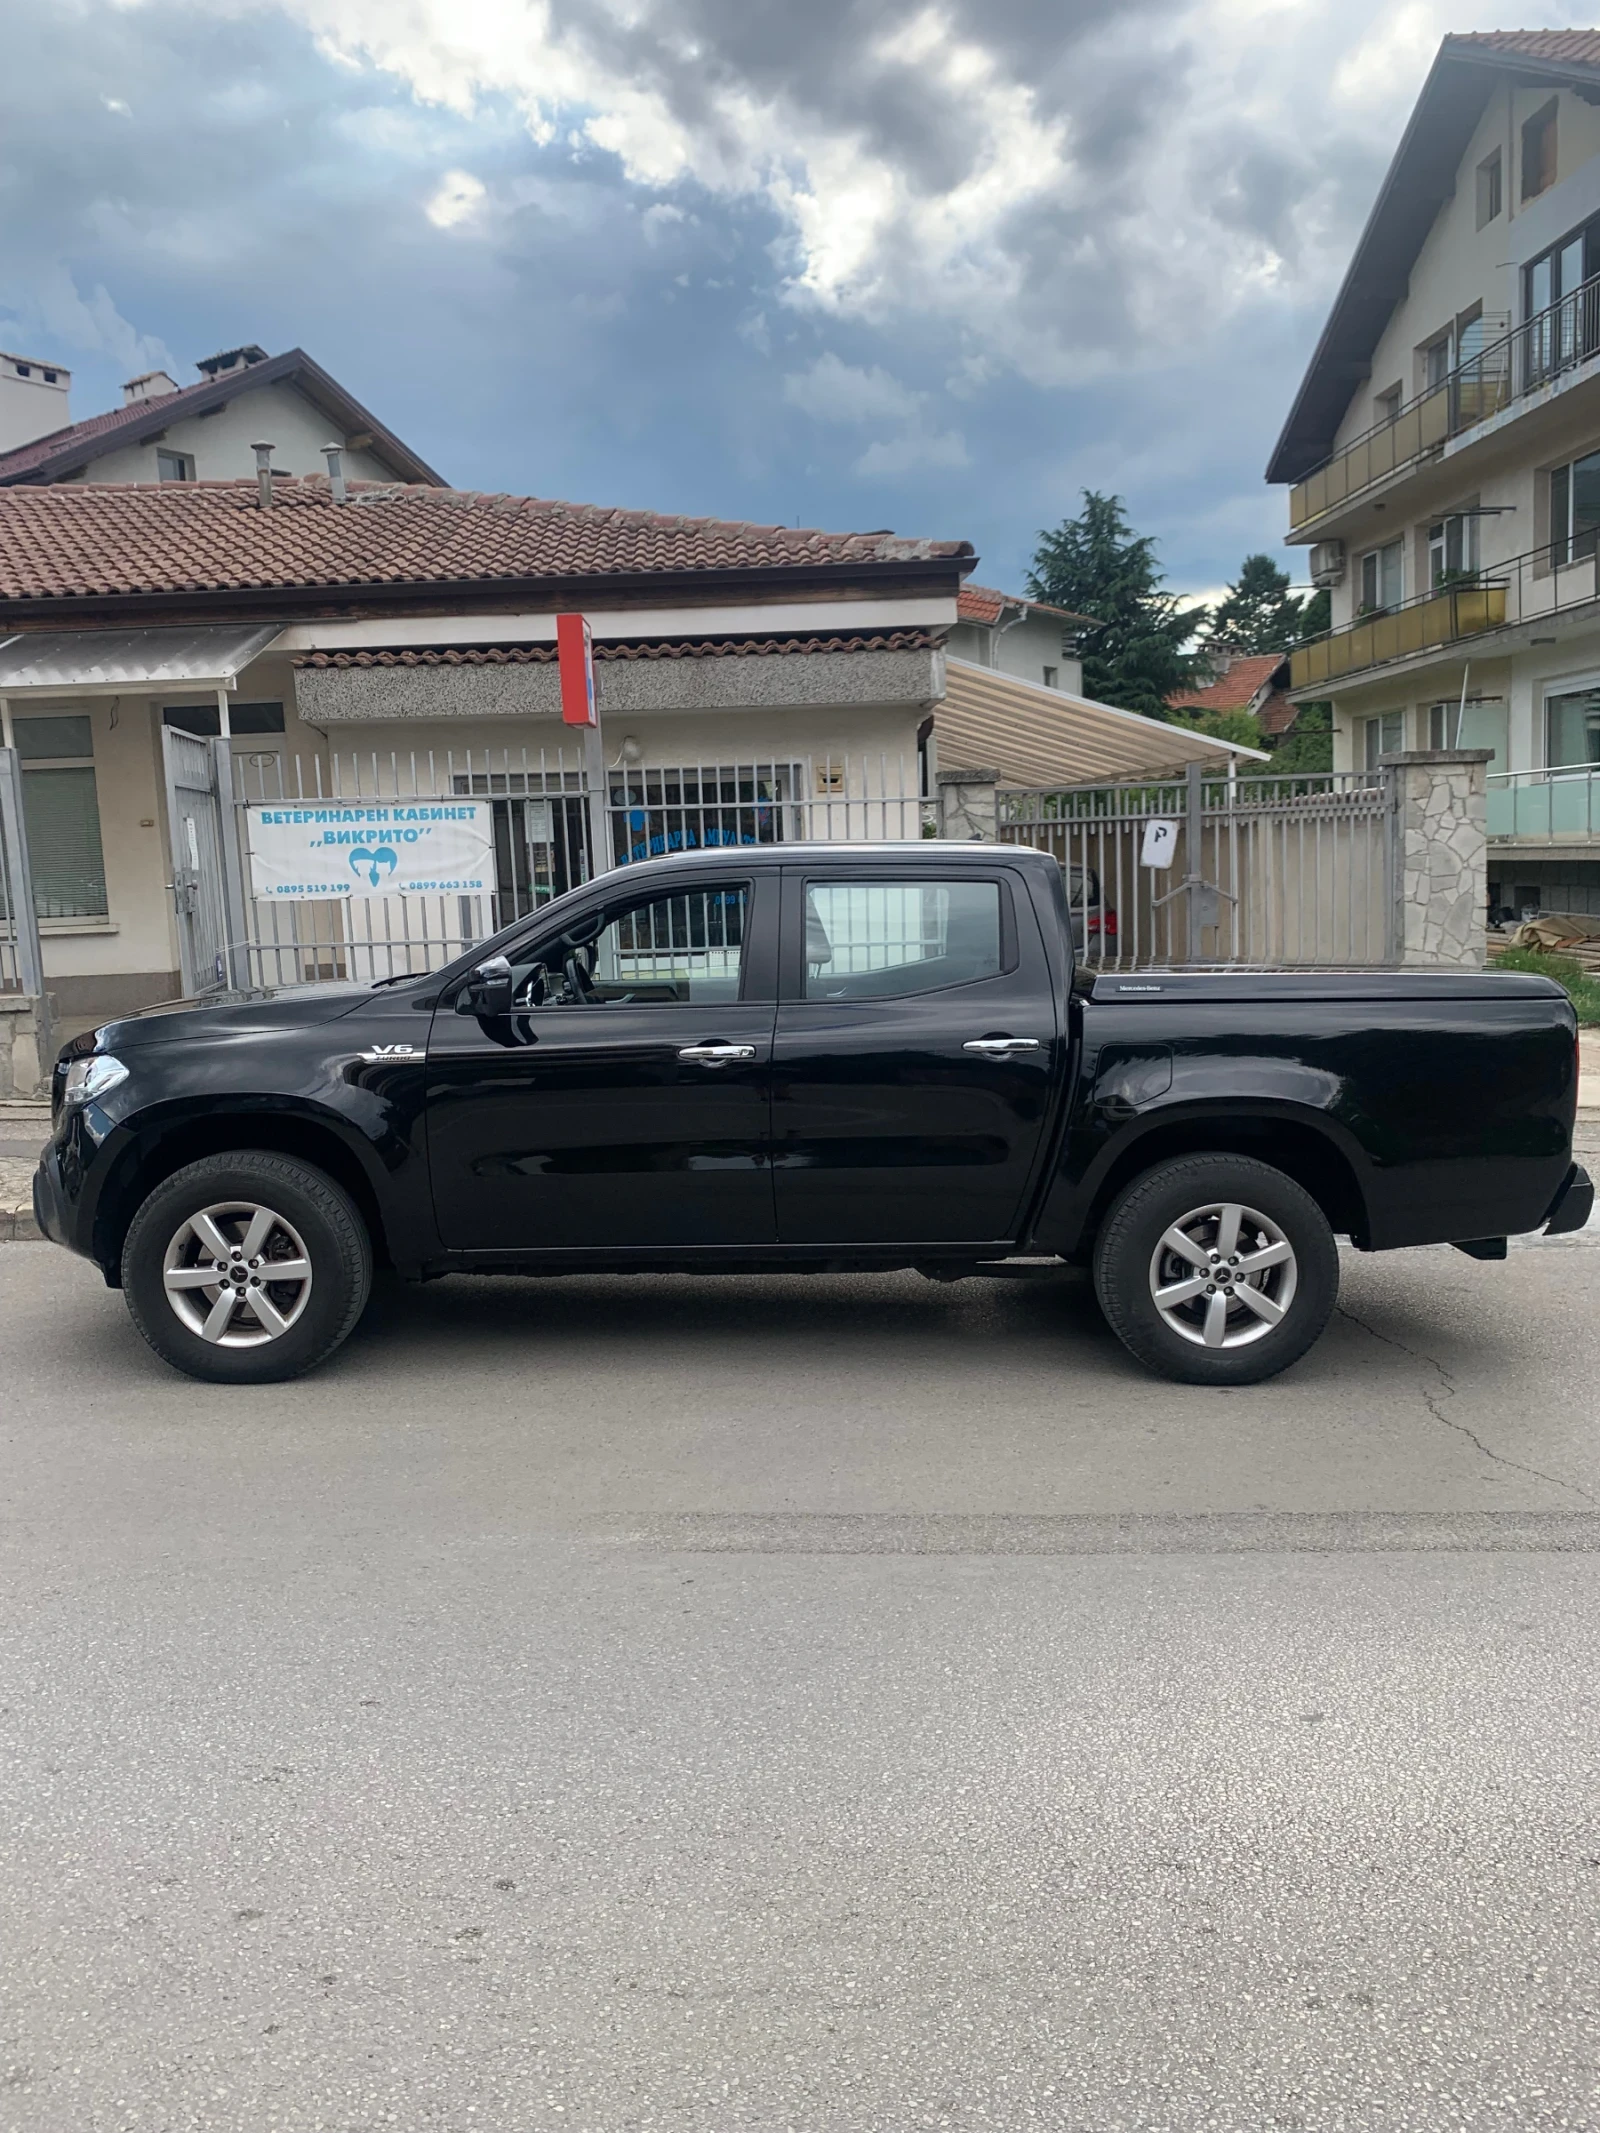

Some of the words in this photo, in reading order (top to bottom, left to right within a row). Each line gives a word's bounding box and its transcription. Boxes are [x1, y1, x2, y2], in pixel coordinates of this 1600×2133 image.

[261, 809, 389, 825] ВЕТЕРИНАРЕН
[393, 807, 476, 821] КАБИНЕТ
[276, 885, 304, 894] 0895
[307, 884, 328, 893] 519
[330, 883, 350, 892] 199
[409, 881, 437, 890] 0899
[439, 881, 460, 889] 663
[462, 880, 483, 888] 158
[371, 1044, 414, 1054] V6
